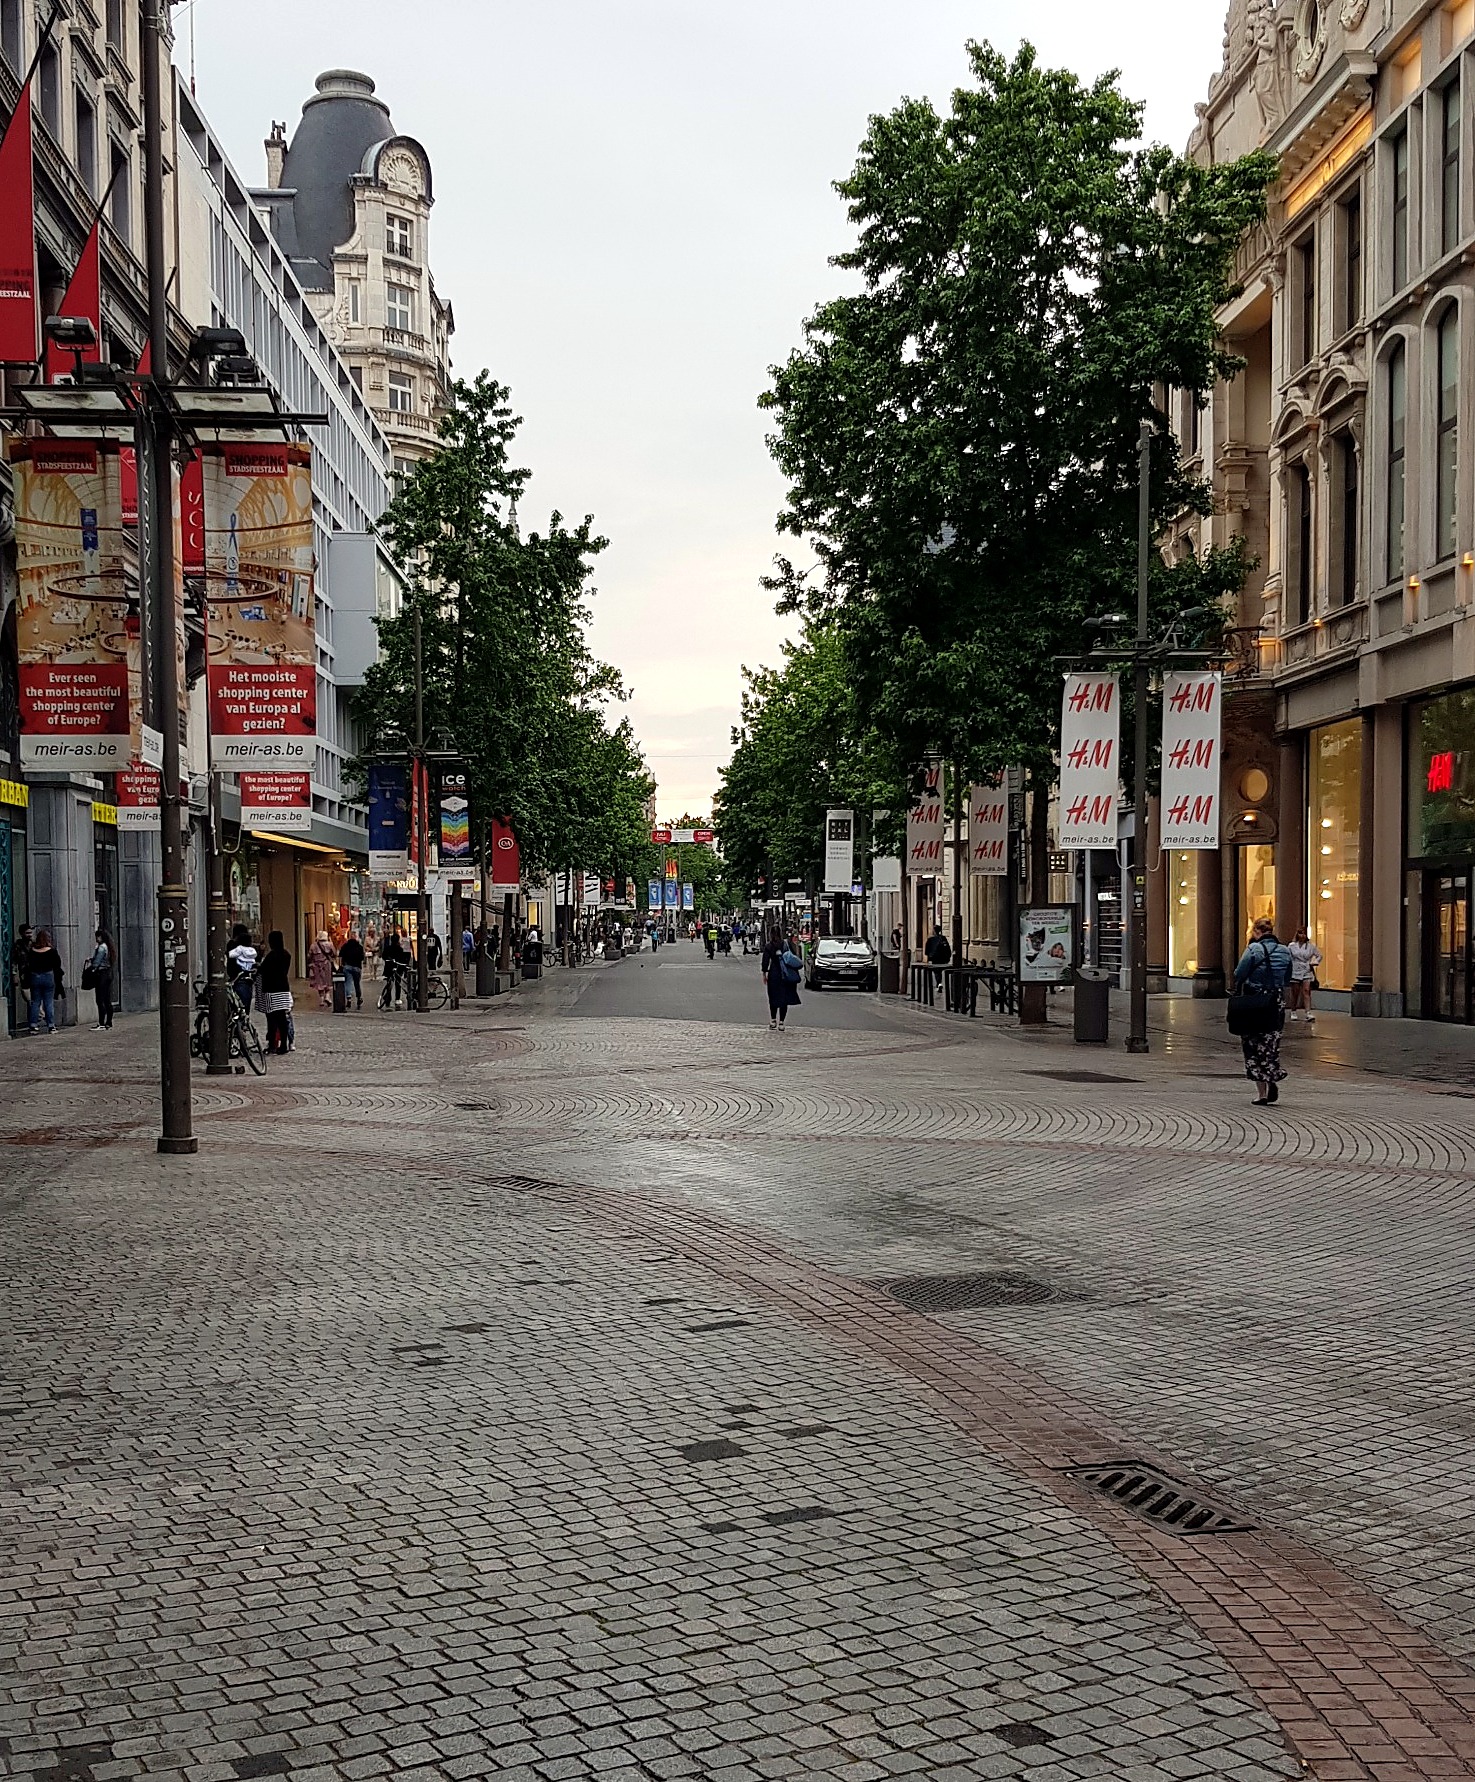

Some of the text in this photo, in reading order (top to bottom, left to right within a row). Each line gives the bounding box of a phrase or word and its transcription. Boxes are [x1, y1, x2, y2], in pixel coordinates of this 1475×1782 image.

[37, 462, 94, 470] STADSFEESTZAAL
[230, 455, 285, 465] SHOPPING
[229, 465, 285, 473] STADSFEESTZAAL
[49, 673, 97, 682] Ever seen
[229, 671, 296, 682] Het mooiste
[26, 686, 121, 696] the most beautiful
[218, 686, 308, 700] shopping center
[1068, 682, 1114, 713] H&M
[1169, 682, 1215, 713] H&M
[33, 701, 115, 713] shopping center
[226, 702, 301, 715] van Europa al
[47, 715, 101, 727] of Europe?
[243, 718, 285, 731] gezien?
[35, 742, 117, 755] meir-as.be
[225, 742, 304, 755] meir-as.be
[1067, 739, 1113, 769] H&M
[1168, 739, 1214, 769] H&M
[249, 785, 280, 793] shopping
[266, 794, 293, 802] Europe?
[250, 812, 302, 820] meir-as.be
[911, 804, 940, 824] H&M
[974, 804, 1004, 824] H&M
[1066, 795, 1112, 825] H&M
[1167, 795, 1213, 825] H&M
[911, 840, 940, 860] H&M
[974, 840, 1004, 860] H&M
